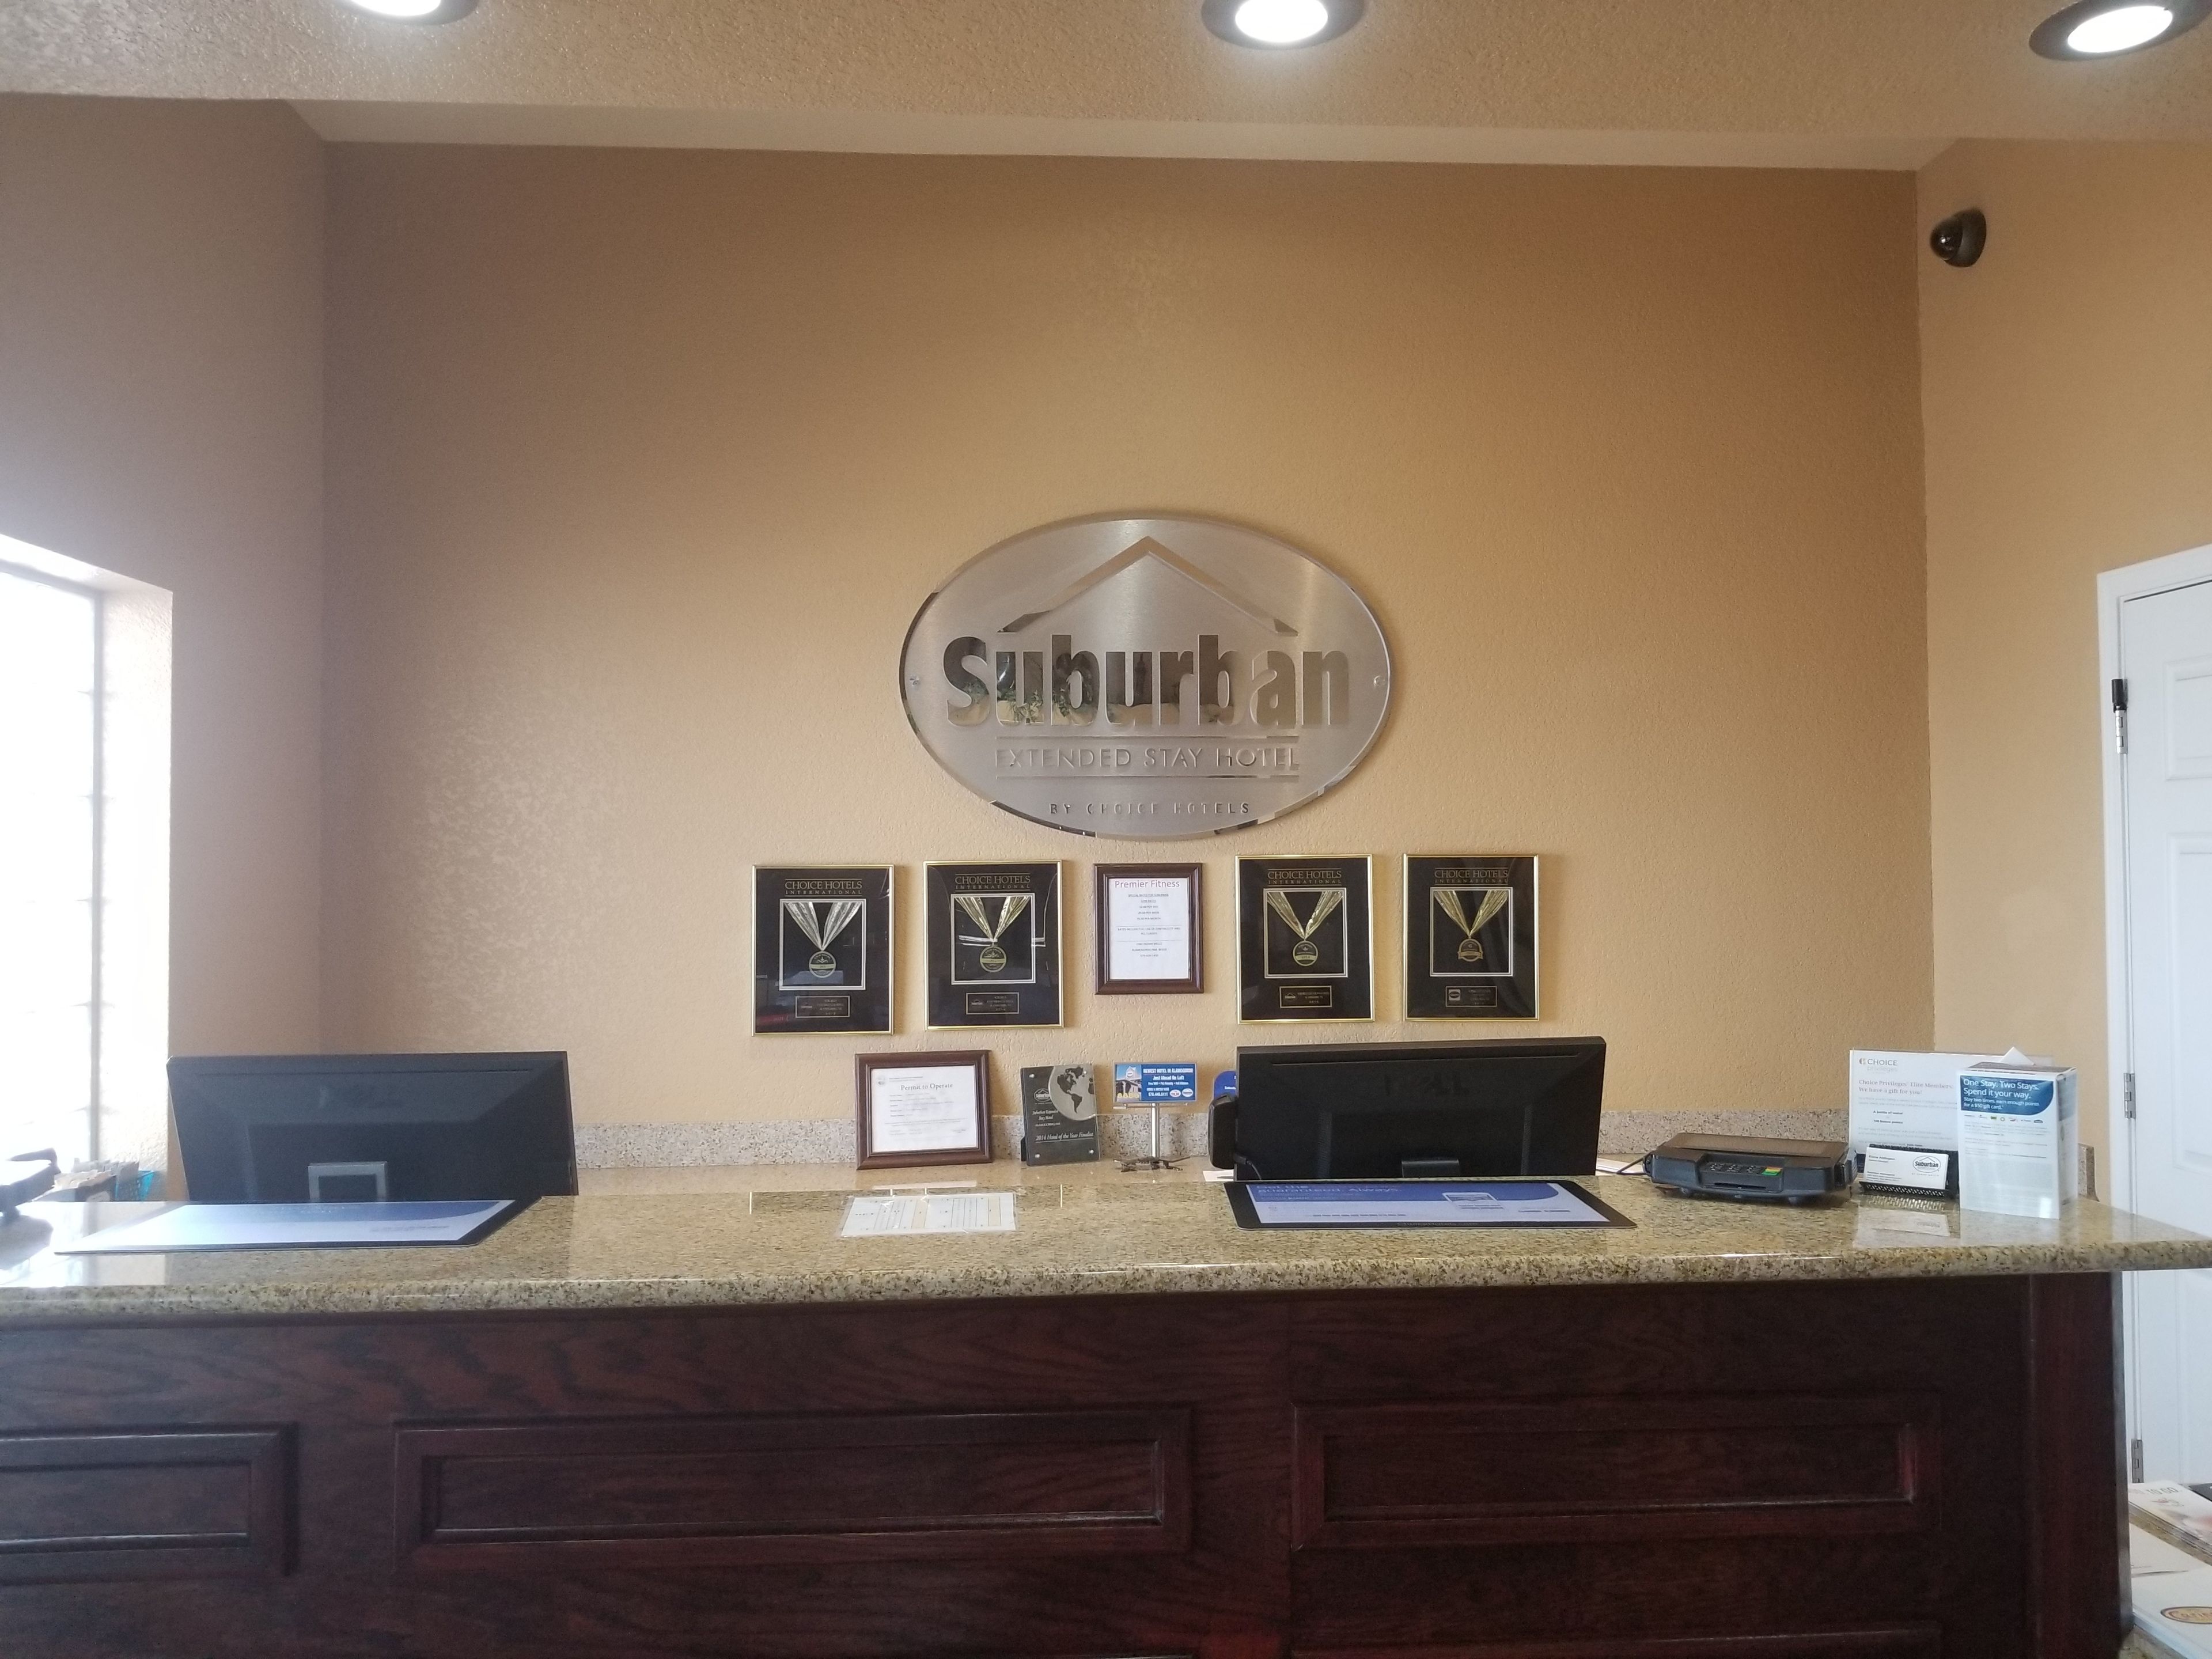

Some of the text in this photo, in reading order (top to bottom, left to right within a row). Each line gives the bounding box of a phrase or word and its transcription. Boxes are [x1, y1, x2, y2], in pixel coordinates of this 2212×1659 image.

[942, 634, 1350, 728] Suburban
[994, 748, 1300, 770] EXTENDED STAY HOTEL
[1049, 803, 1249, 815] BY CHOICE HOTELS
[1267, 870, 1342, 879] CHOICE HOTELS
[1434, 870, 1508, 878] CHOICE HOTELS
[955, 875, 1031, 884] CHOICE HOTELS
[1115, 880, 1180, 888] Premier Fitness
[785, 881, 862, 889] CHOICE HOTELS
[1980, 1080, 1998, 1089] Stay.
[2017, 1082, 2039, 1091] Stays.
[1963, 1088, 1987, 1096] Spend
[1994, 1091, 2014, 1099] your
